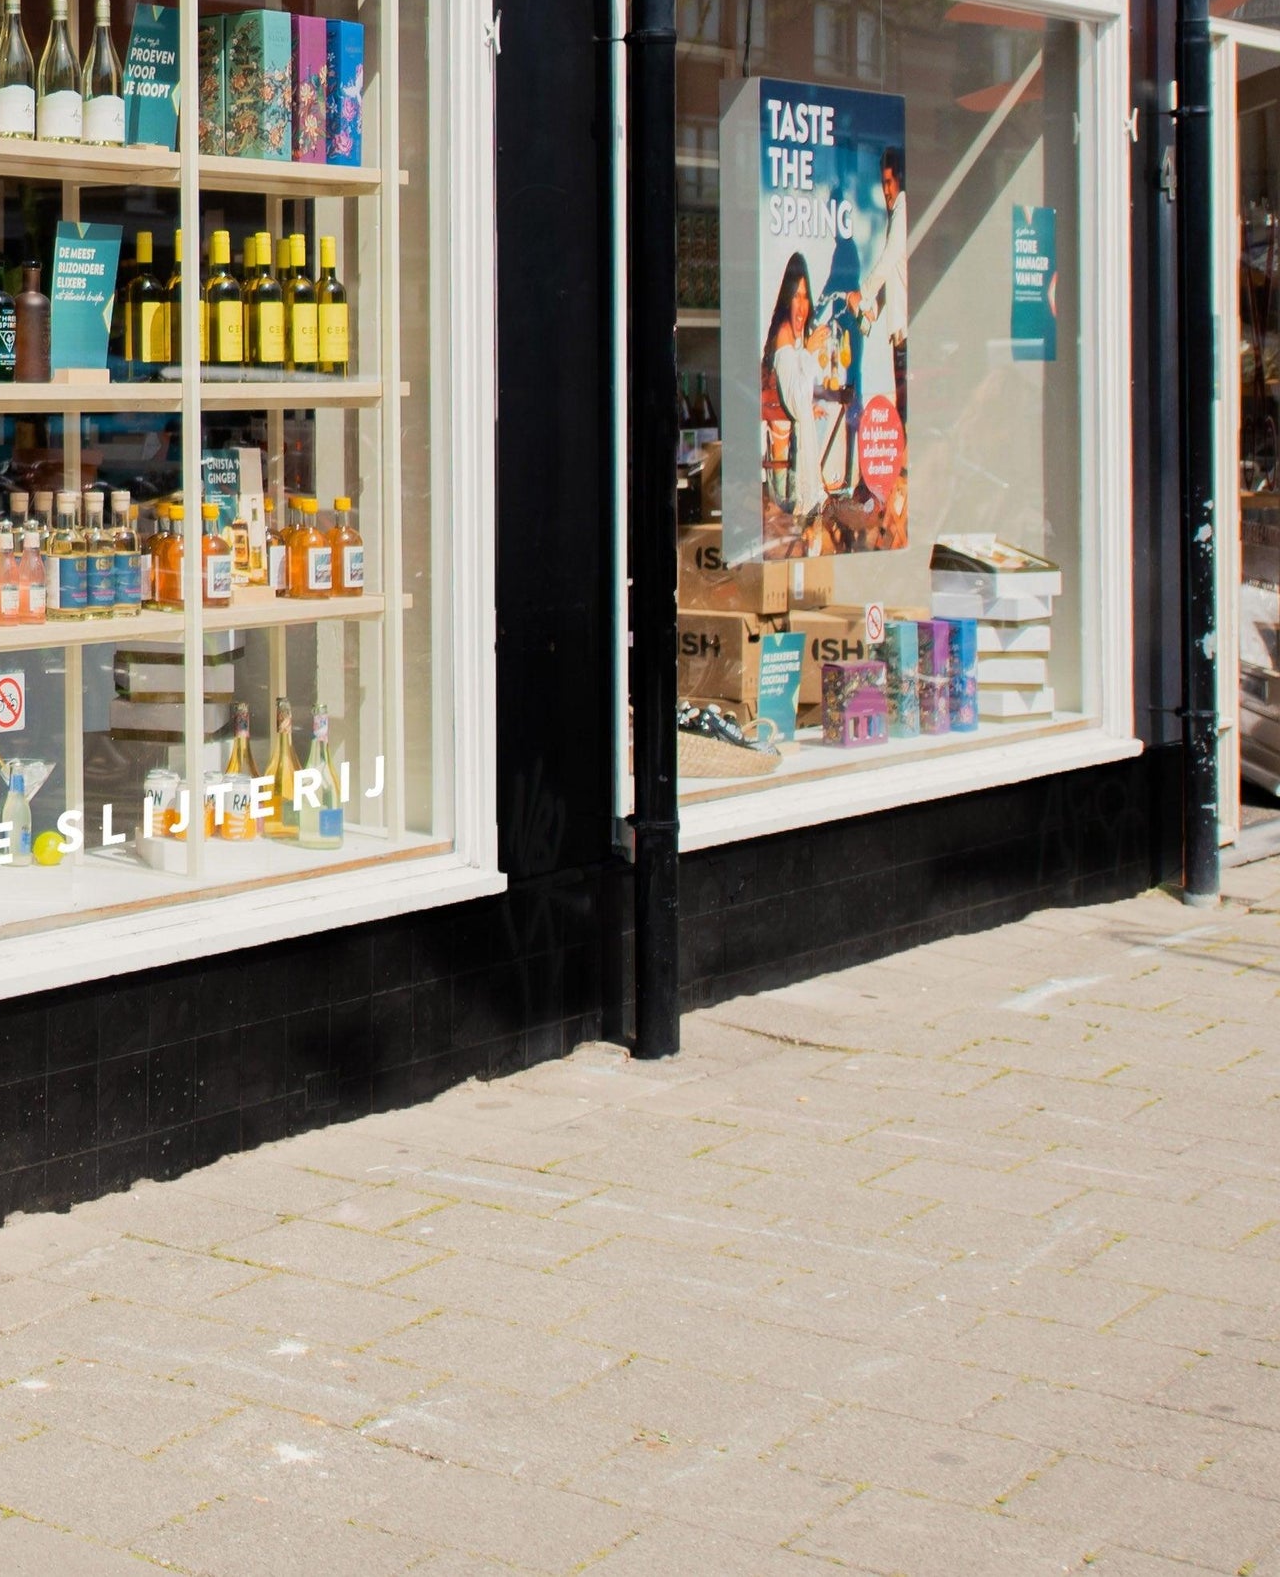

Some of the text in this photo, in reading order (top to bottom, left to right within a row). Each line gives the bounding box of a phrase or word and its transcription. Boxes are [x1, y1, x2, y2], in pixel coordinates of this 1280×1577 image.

[130, 47, 175, 65] PROEVEN
[128, 64, 156, 80] VOOR
[123, 81, 170, 99] JE KOOPT
[767, 99, 835, 146] TASTE
[768, 146, 813, 190] THE
[769, 194, 853, 239] SPRING
[59, 247, 97, 260] DE MEEST
[1015, 238, 1038, 254] STORE
[208, 473, 237, 484] GINGER
[695, 546, 728, 571] IS
[811, 638, 864, 661] ISH
[54, 754, 388, 858] SLIJTERIJ
